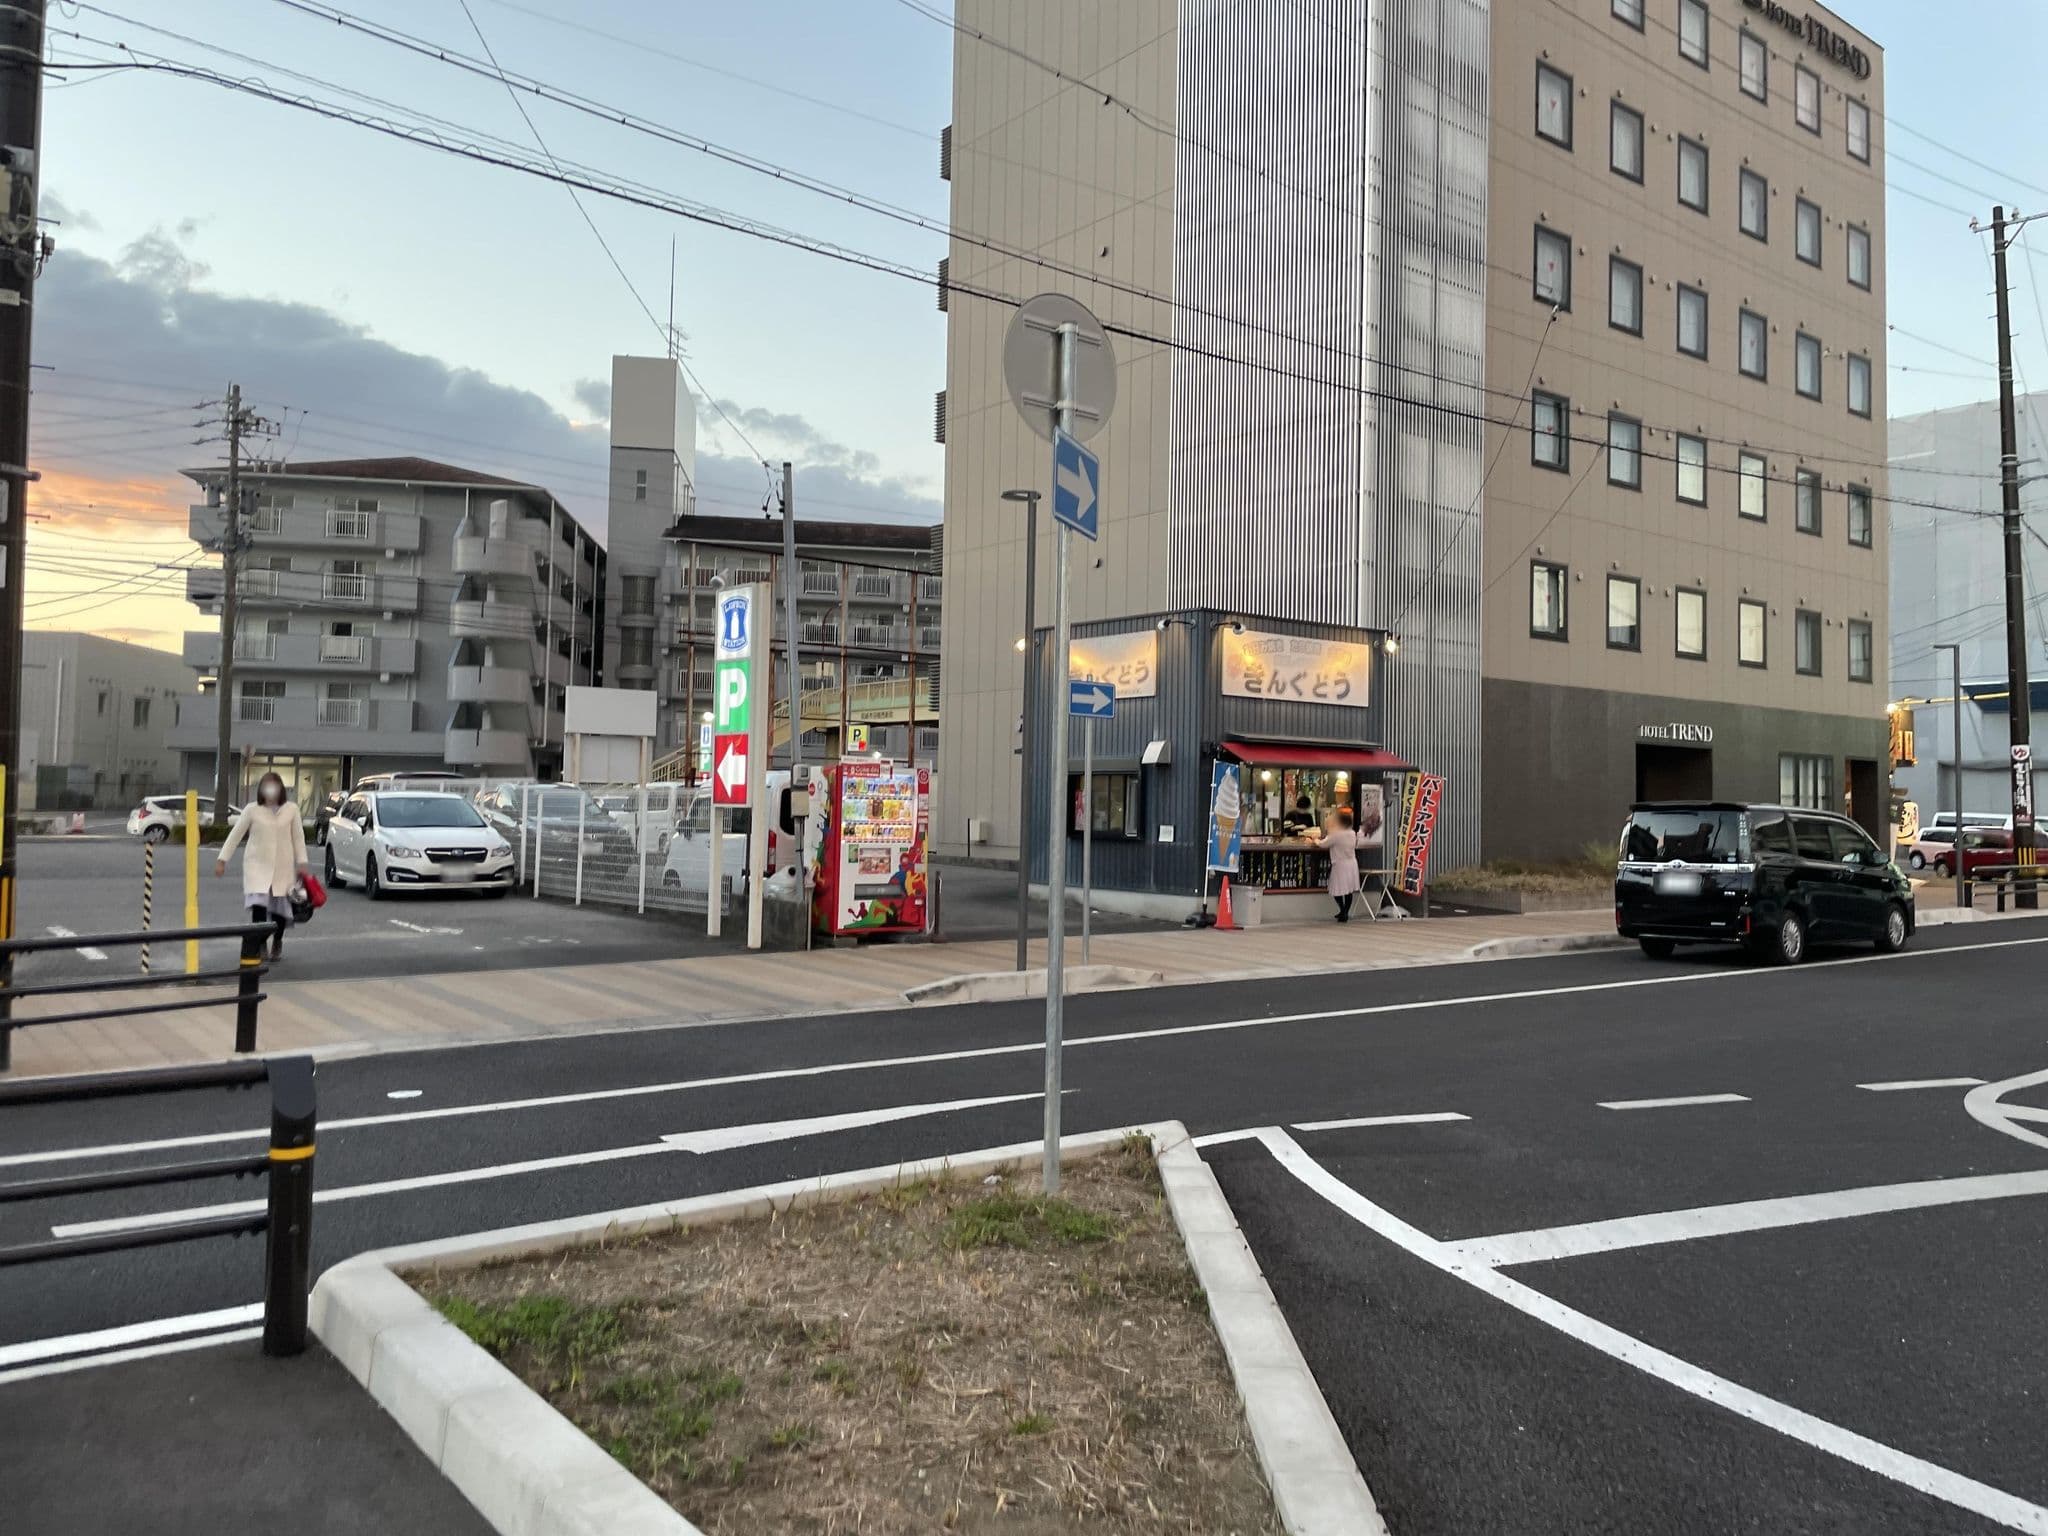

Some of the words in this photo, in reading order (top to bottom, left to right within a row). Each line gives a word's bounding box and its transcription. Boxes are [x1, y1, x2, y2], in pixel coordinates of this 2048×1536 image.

[1804, 12, 1872, 80] TREND
[719, 668, 747, 726] P
[853, 729, 862, 741] P
[1640, 725, 1669, 739] HOTEL
[1670, 722, 1713, 742] TREND
